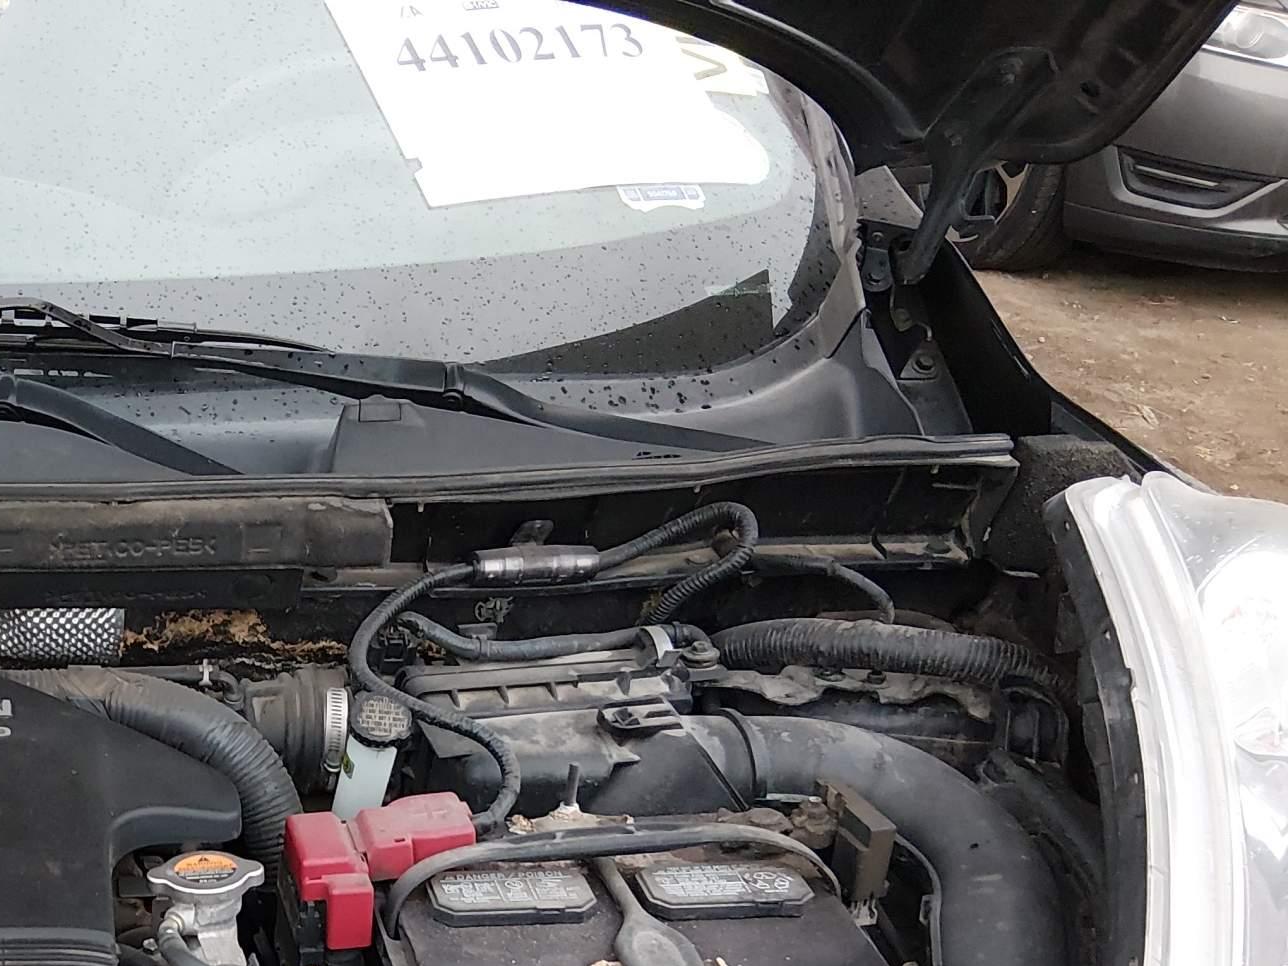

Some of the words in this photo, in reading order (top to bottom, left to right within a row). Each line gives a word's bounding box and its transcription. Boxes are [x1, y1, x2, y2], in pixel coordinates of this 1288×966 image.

[396, 23, 644, 72] 44102173
[456, 872, 504, 881] DANGER
[517, 870, 564, 879] POISON
